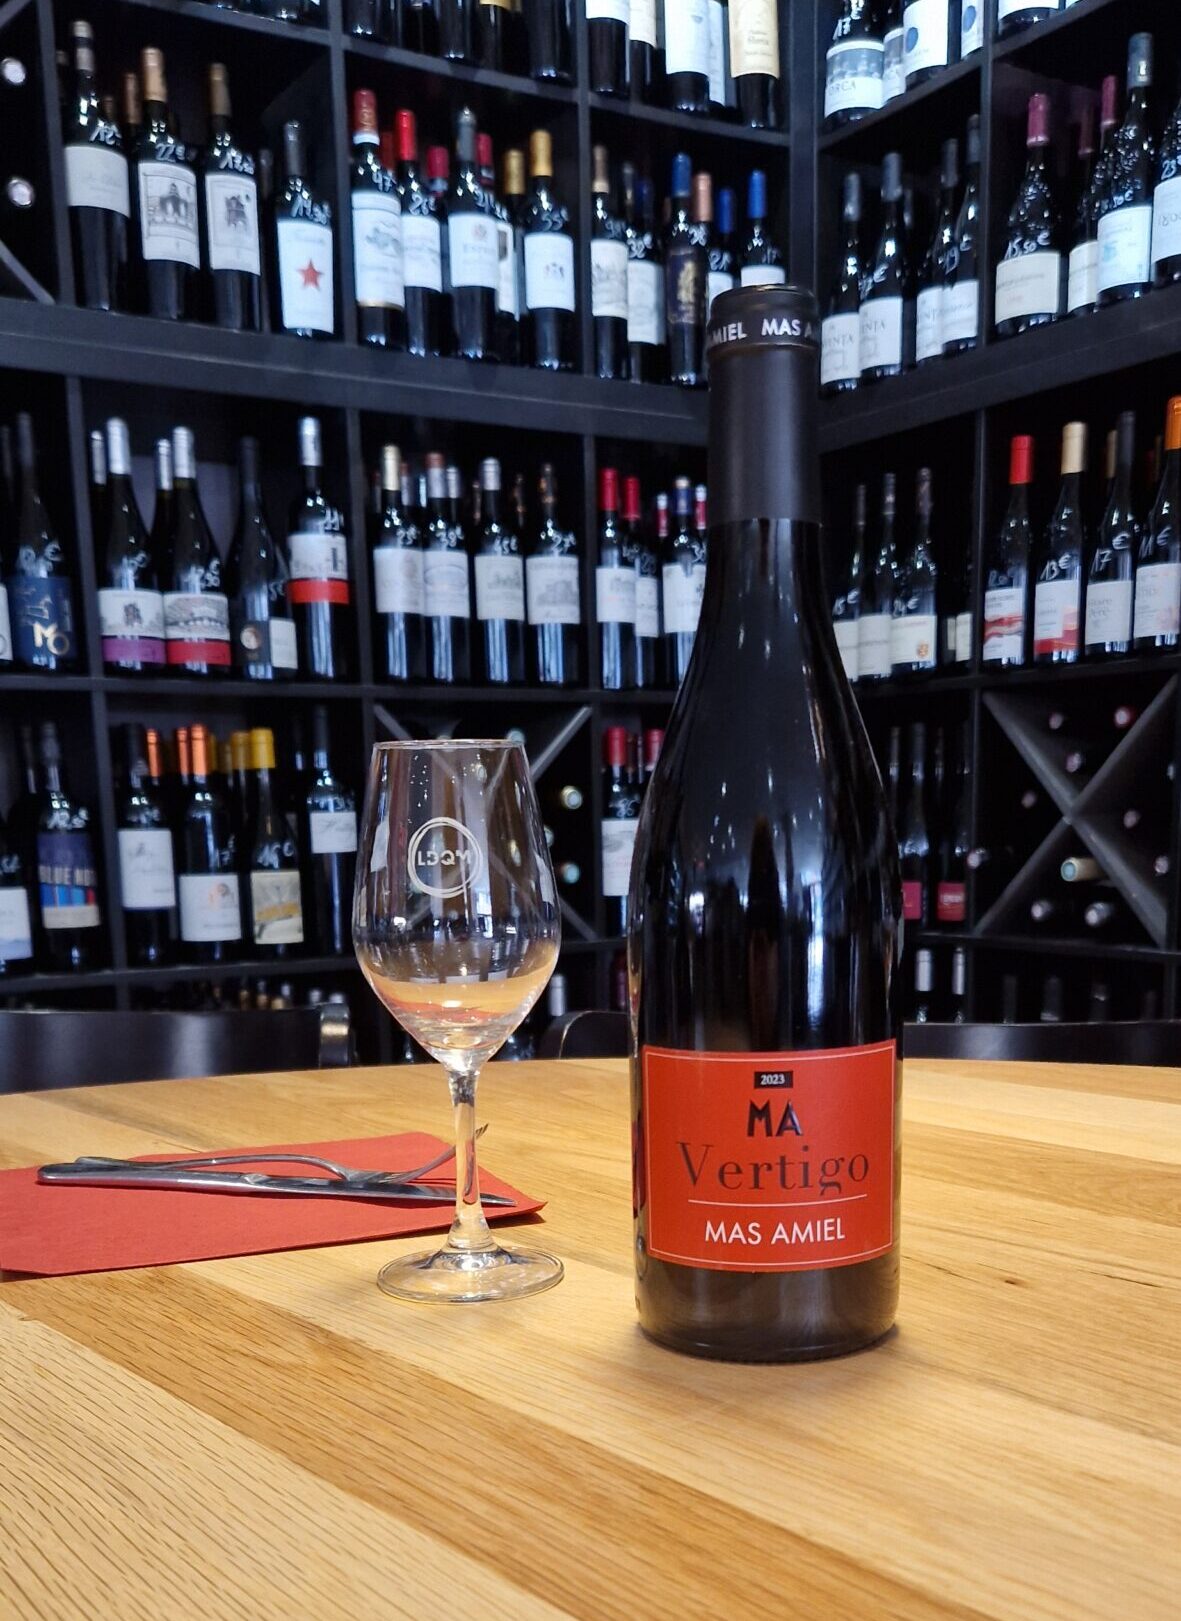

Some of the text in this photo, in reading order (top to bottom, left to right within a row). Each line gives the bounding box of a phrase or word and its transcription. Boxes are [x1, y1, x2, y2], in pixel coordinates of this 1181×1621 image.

[761, 317, 801, 337] MAS
[760, 1073, 786, 1086] 2023
[747, 1099, 803, 1137] MA
[676, 1141, 869, 1196] Vertigo
[704, 1217, 846, 1245] MAS AMIEL
